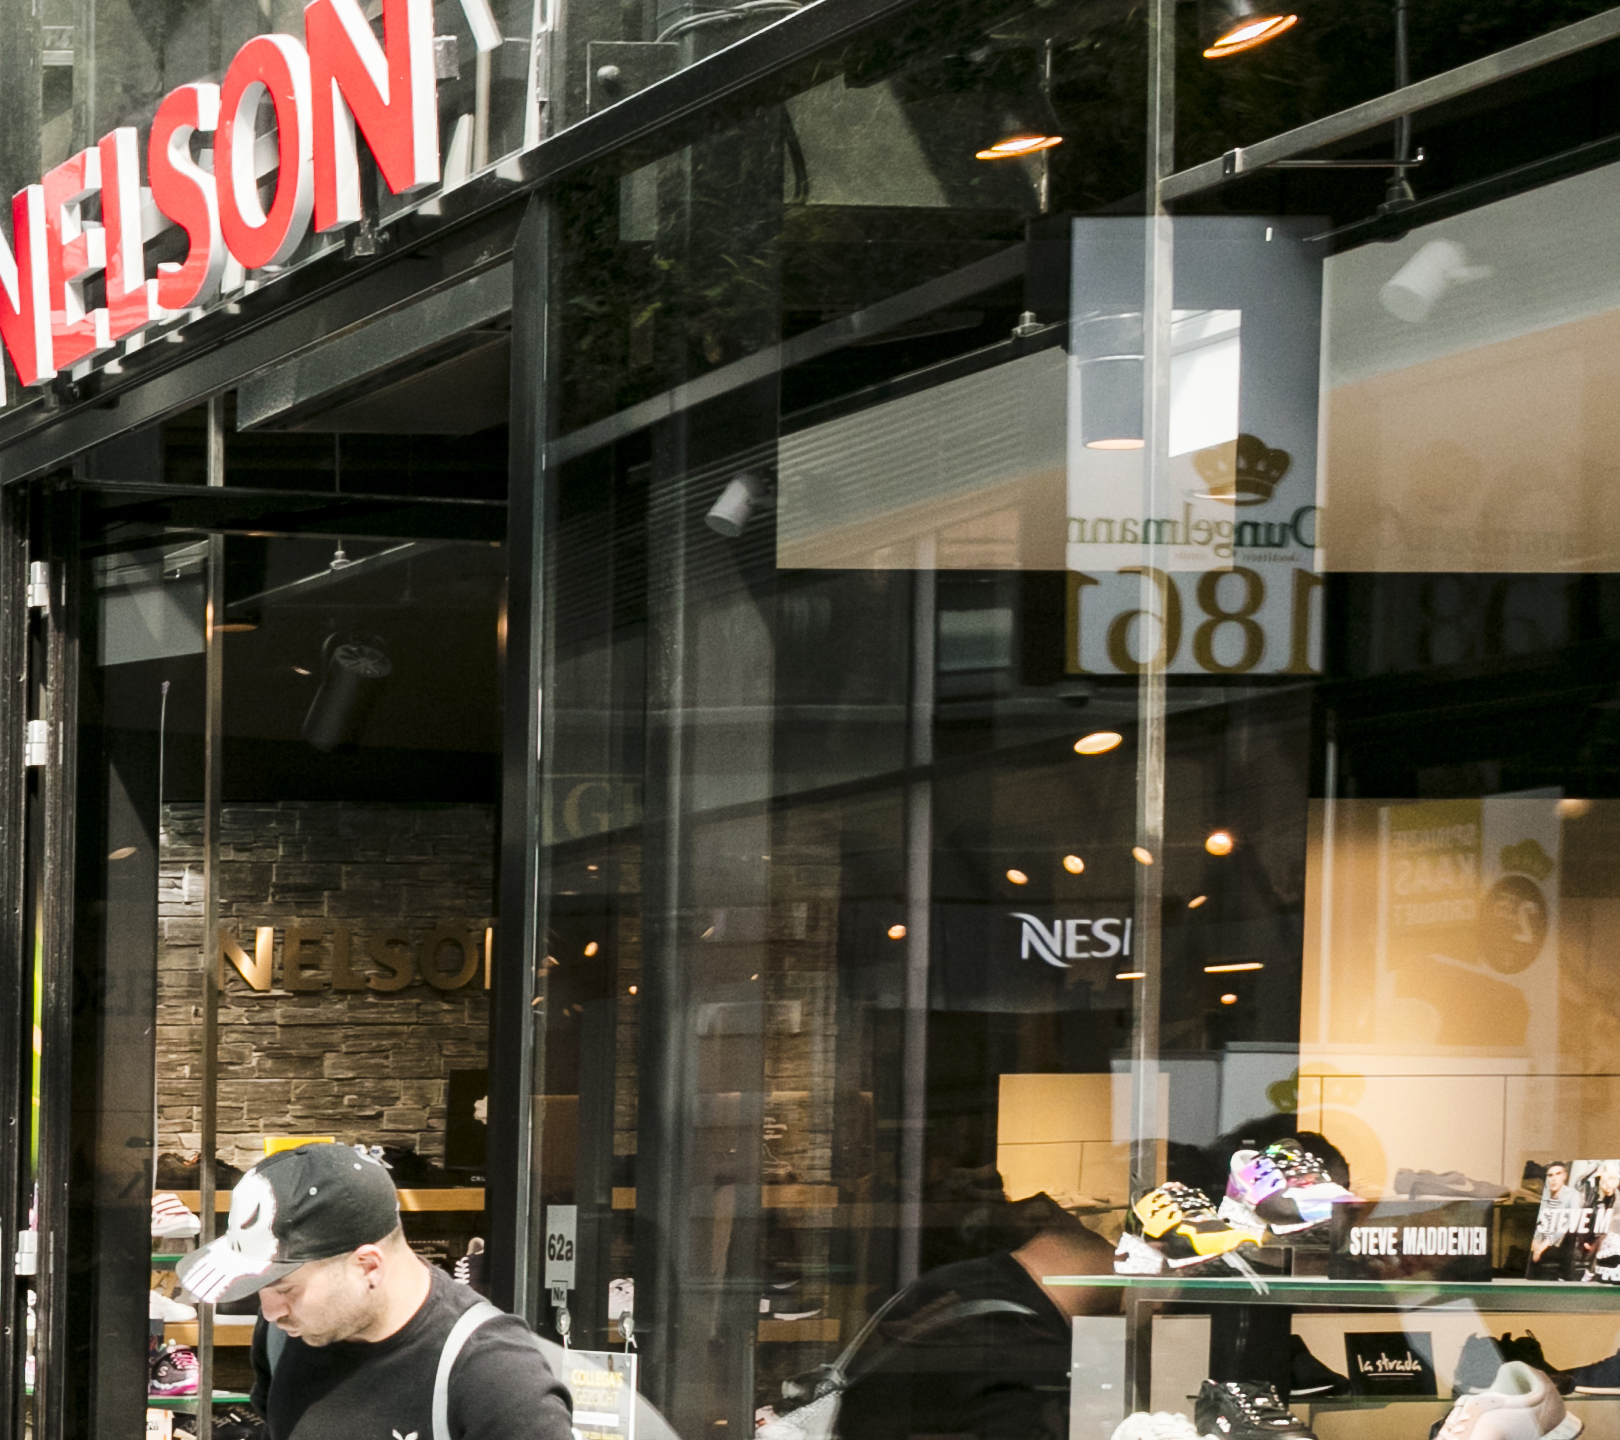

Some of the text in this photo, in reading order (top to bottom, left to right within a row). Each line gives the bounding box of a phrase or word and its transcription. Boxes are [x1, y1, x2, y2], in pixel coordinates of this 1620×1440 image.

[547, 1233, 574, 1262] 62a
[1349, 1226, 1398, 1256] STEVE
[1357, 1350, 1422, 1373] la strada
